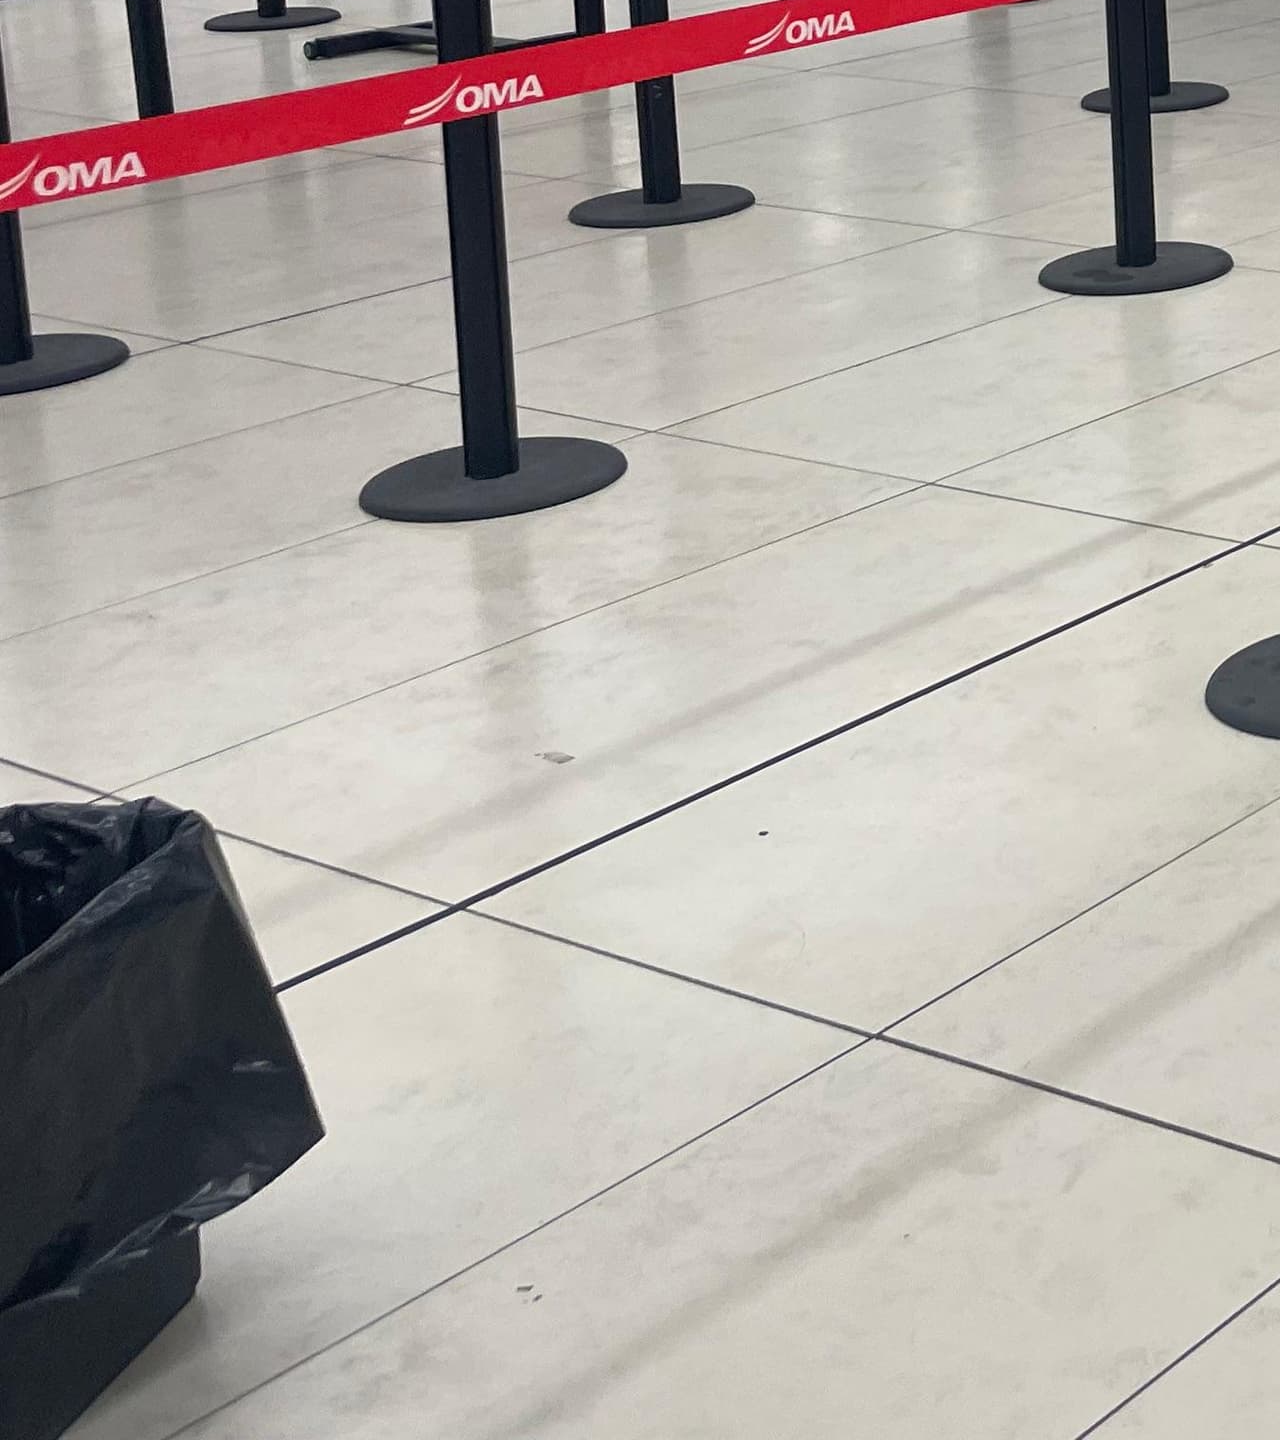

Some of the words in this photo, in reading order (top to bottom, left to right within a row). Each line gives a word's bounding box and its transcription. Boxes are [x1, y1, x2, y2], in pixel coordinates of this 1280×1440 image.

[785, 10, 856, 46] OMA
[455, 74, 545, 114] OMA
[34, 152, 146, 198] OMA
